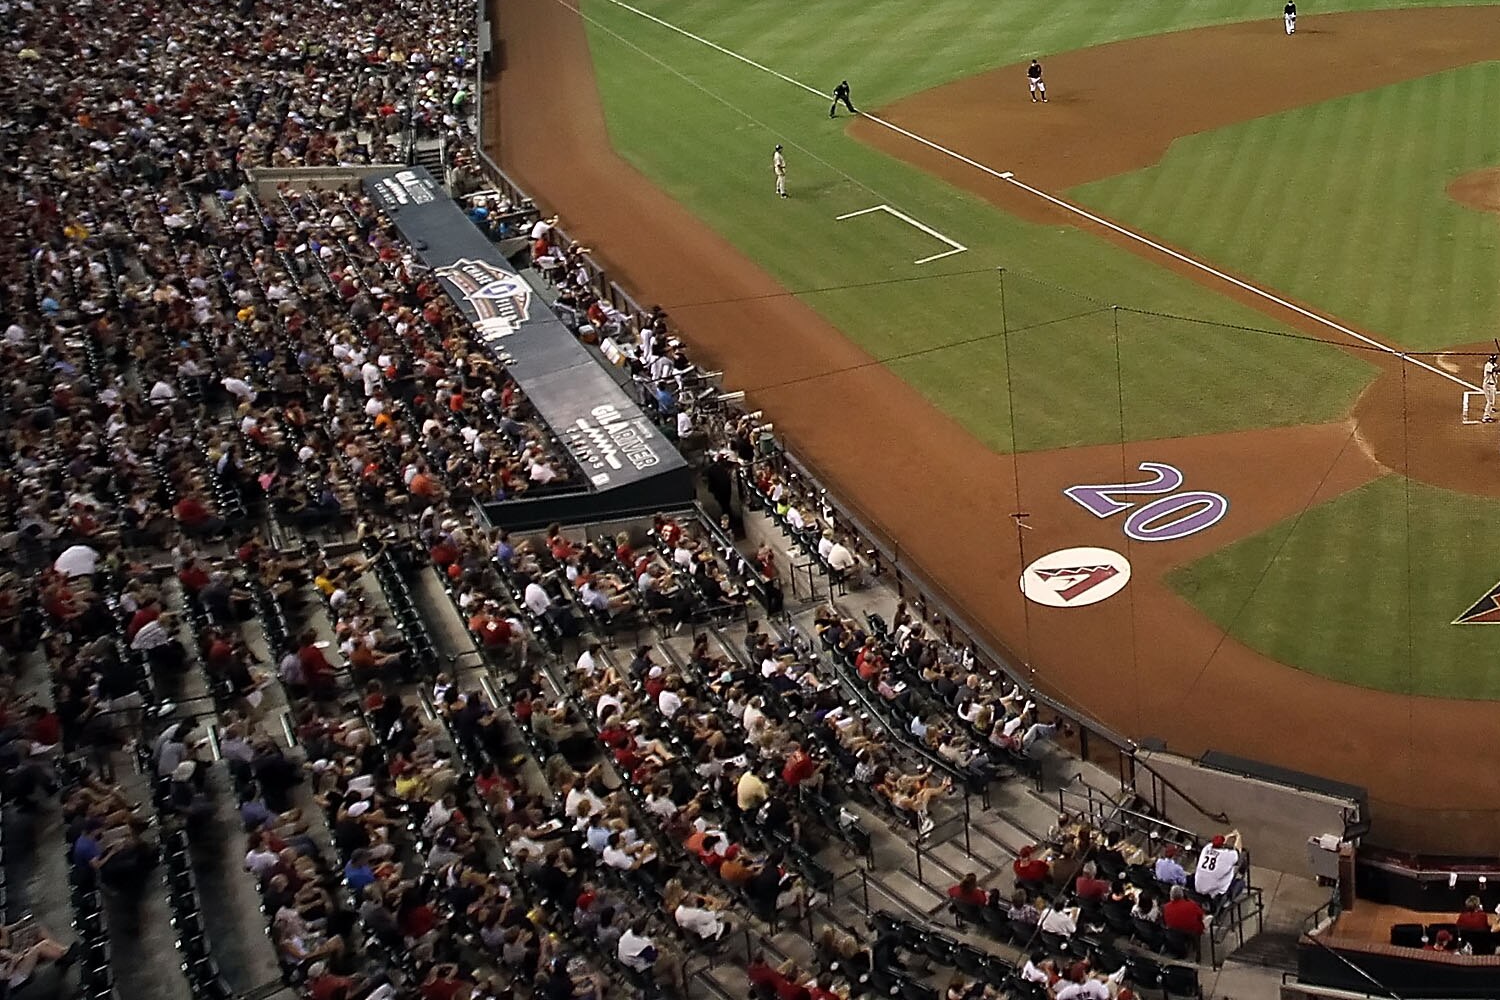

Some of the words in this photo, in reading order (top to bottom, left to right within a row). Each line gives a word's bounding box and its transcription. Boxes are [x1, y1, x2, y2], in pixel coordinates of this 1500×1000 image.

[462, 265, 495, 285] CHASE
[1063, 462, 1229, 542] 20
[1201, 855, 1217, 871] 28
